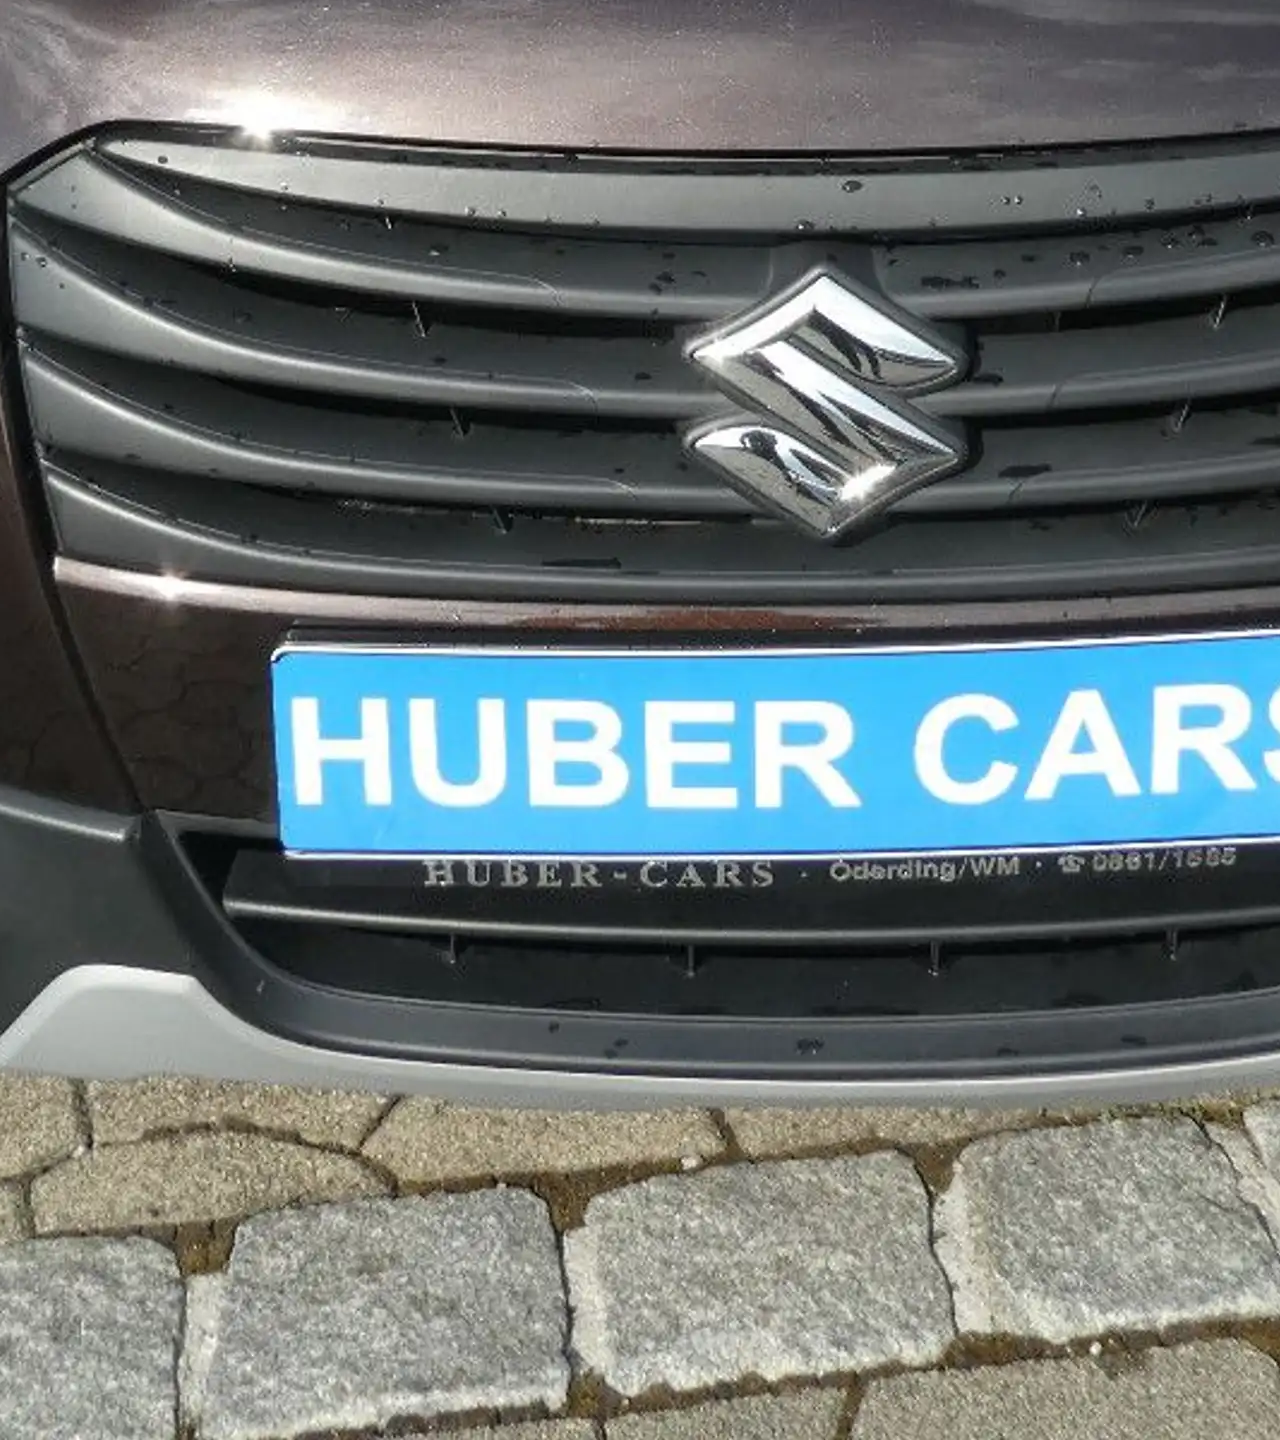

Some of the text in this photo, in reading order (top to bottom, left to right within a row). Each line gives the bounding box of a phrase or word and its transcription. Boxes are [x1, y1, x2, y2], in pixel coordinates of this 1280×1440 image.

[290, 694, 864, 810] HUBER
[423, 859, 775, 888] HUBER-CARS
[829, 856, 1020, 882] Oderding/WM
